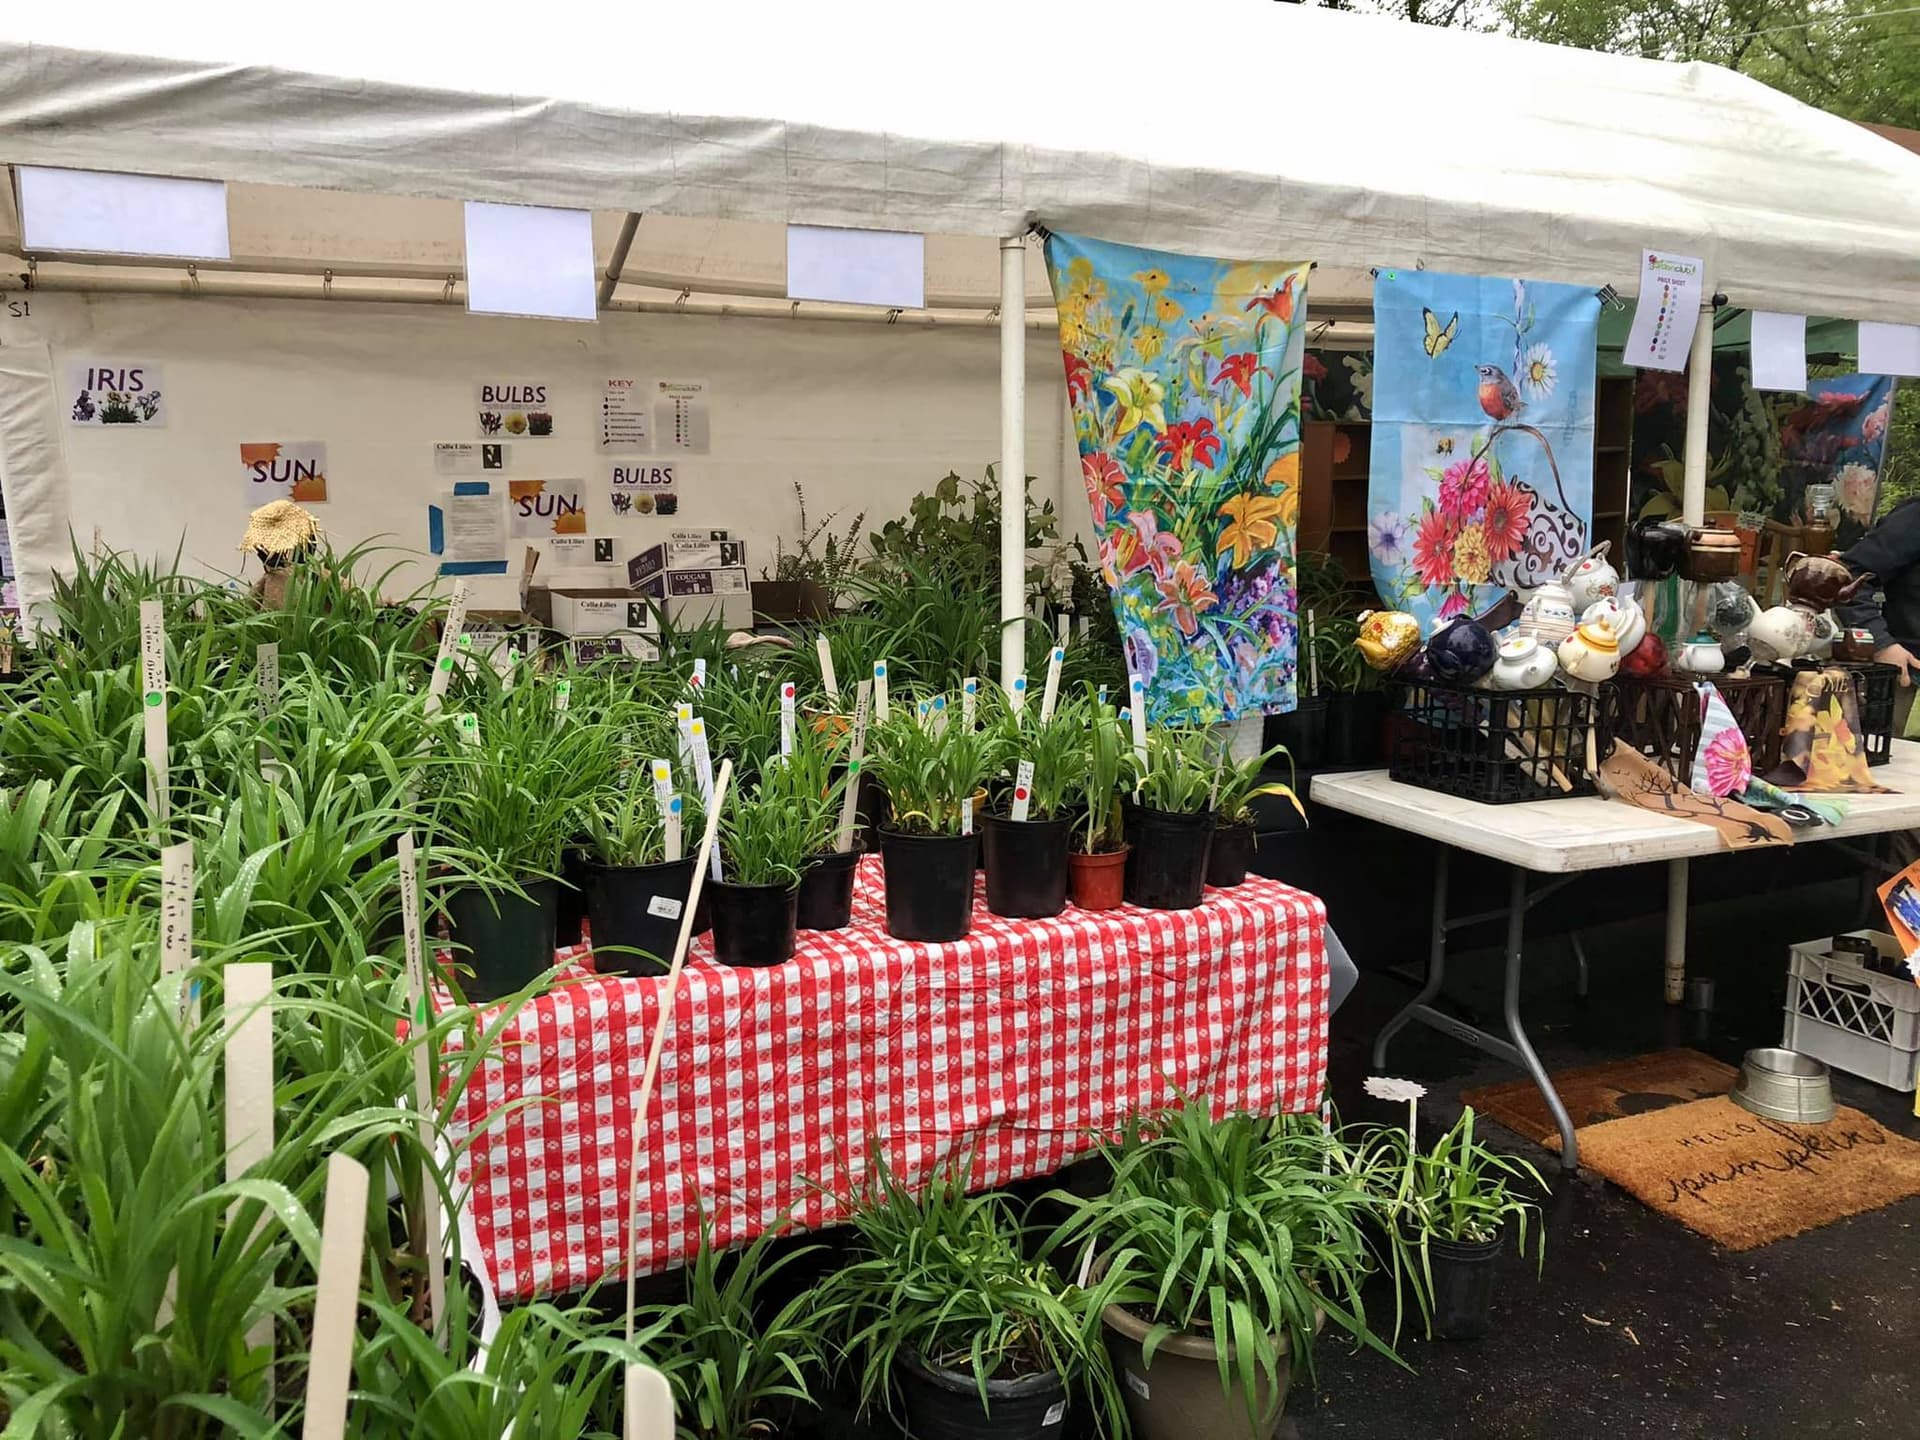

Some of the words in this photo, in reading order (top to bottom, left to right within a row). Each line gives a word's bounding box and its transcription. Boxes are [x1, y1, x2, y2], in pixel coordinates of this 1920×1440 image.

[8, 301, 31, 317] S1
[87, 367, 144, 392] IRIS
[608, 379, 634, 388] KEY
[482, 385, 546, 403] BULBS
[436, 442, 454, 450] Calla
[252, 458, 317, 483] SUN
[613, 467, 673, 484] BULBS
[519, 494, 577, 517] SUN
[676, 541, 692, 549] Calla
[675, 573, 708, 581] COUGAR
[581, 601, 598, 609] Calla
[1676, 1123, 1756, 1149] HELLO
[1665, 1118, 1886, 1203] pumpkin
